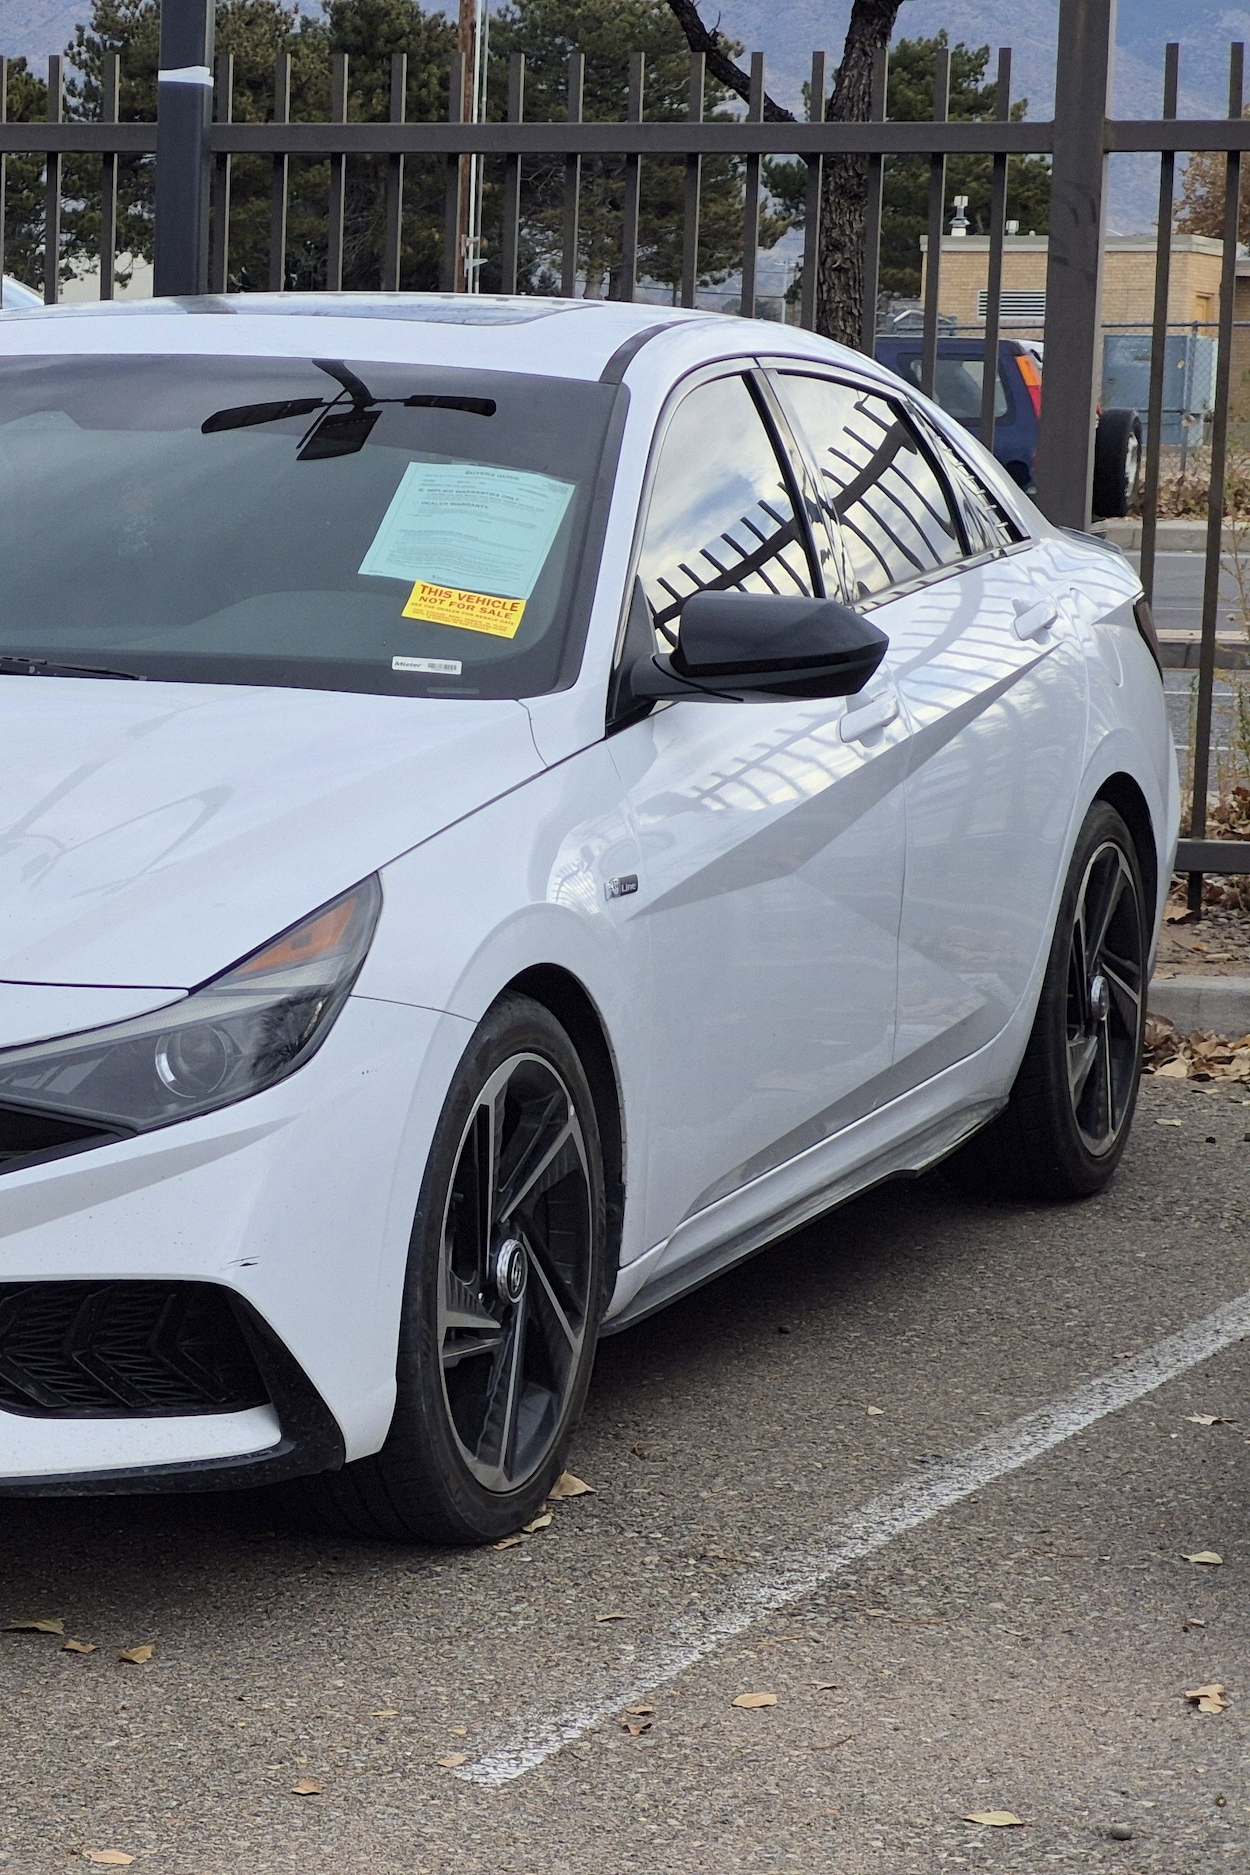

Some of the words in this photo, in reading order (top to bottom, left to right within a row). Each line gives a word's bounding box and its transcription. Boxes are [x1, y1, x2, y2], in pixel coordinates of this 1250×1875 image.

[419, 596, 446, 607] NOT
[448, 601, 476, 612] FOR
[479, 607, 514, 620] SALE
[420, 584, 453, 599] THIS
[458, 592, 521, 612] VEHICLE
